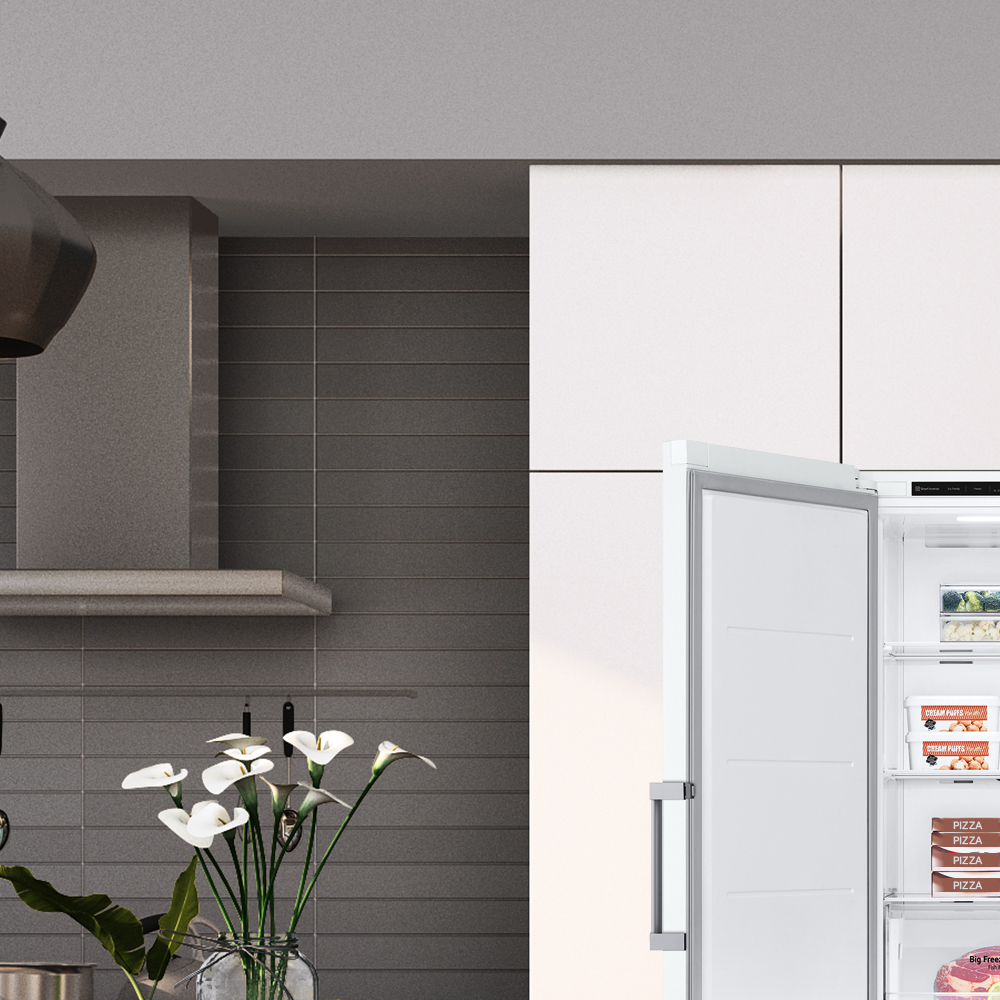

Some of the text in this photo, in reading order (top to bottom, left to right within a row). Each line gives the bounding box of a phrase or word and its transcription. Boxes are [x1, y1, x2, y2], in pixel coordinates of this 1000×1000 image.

[925, 709, 946, 717] CREAM
[953, 821, 983, 830] PIZZA
[953, 836, 983, 845] PIZZA
[953, 856, 983, 865] PIZZA
[953, 881, 983, 890] PIZZA
[969, 956, 981, 965] Big
